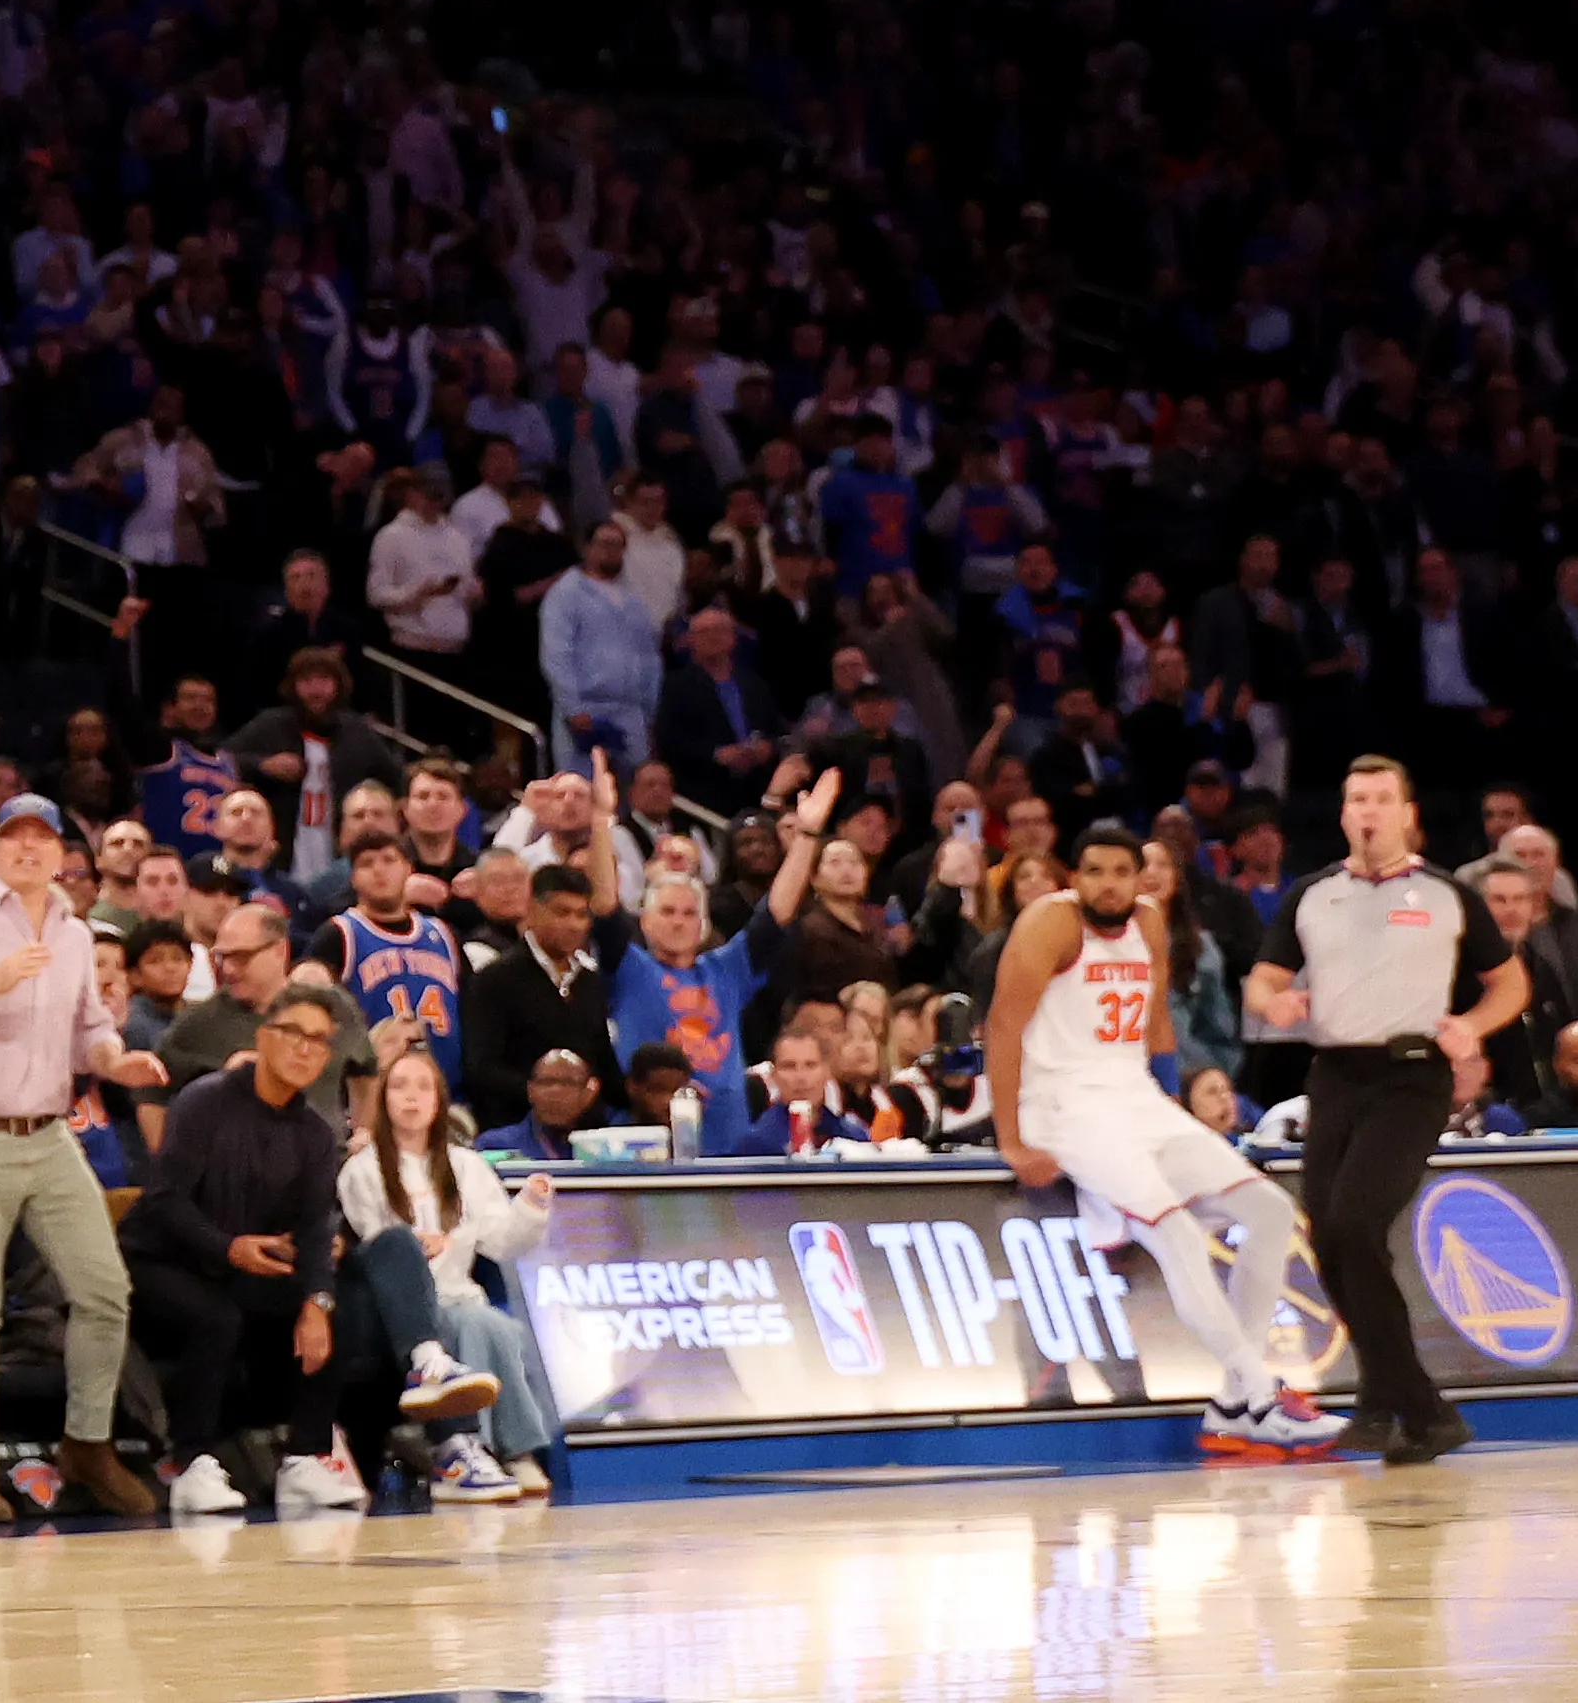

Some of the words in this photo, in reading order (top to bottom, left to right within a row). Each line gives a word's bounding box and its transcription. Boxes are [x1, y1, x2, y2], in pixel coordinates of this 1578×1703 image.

[387, 984, 450, 1036] 14
[1095, 990, 1145, 1042] 32
[535, 1257, 778, 1309] AMERICAN
[867, 1216, 1137, 1366] TIP-OFF
[580, 1302, 792, 1353] EXPRESS
